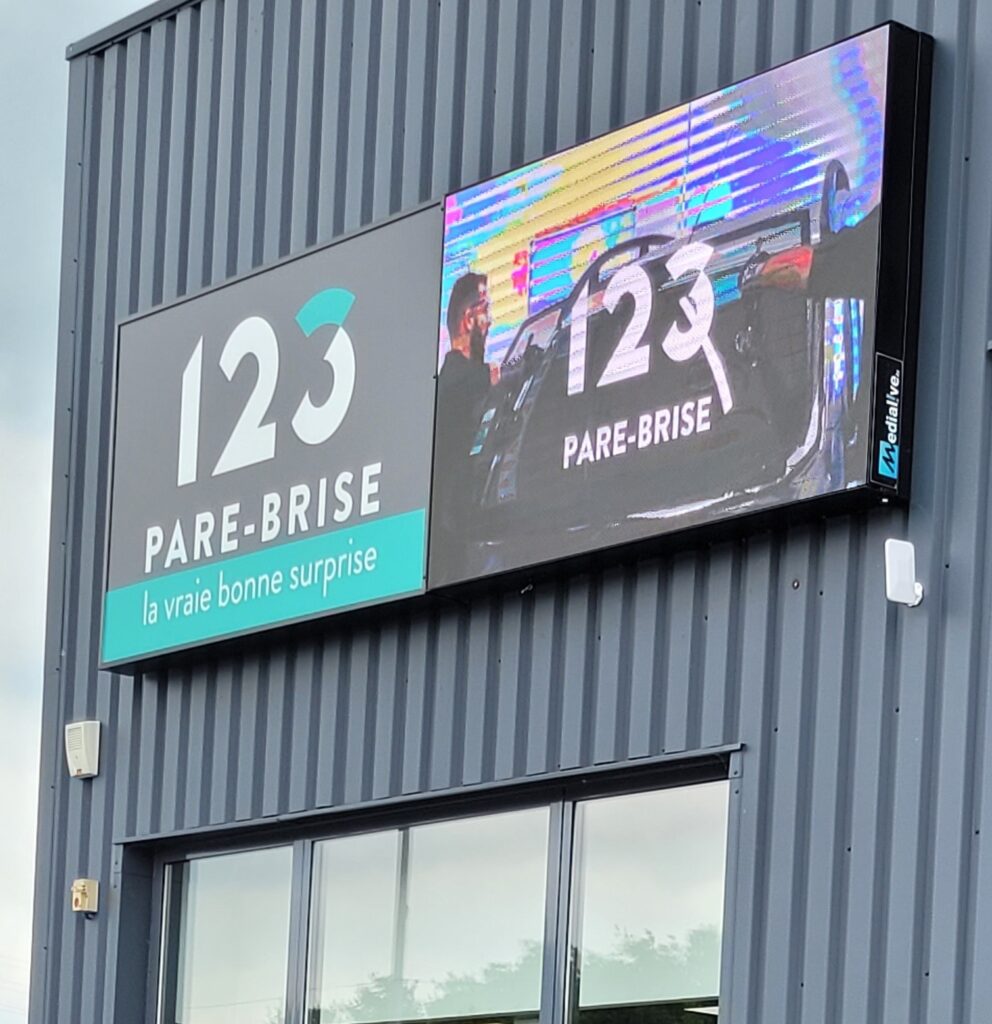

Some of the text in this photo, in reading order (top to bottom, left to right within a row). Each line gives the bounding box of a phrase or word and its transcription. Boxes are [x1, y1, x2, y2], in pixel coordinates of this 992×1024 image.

[567, 241, 732, 415] 123
[177, 287, 356, 487] 123
[562, 396, 713, 470] PARE-BRISE
[144, 462, 382, 574] PARE-BRISE
[142, 538, 378, 625] la vraie bonne surprise
